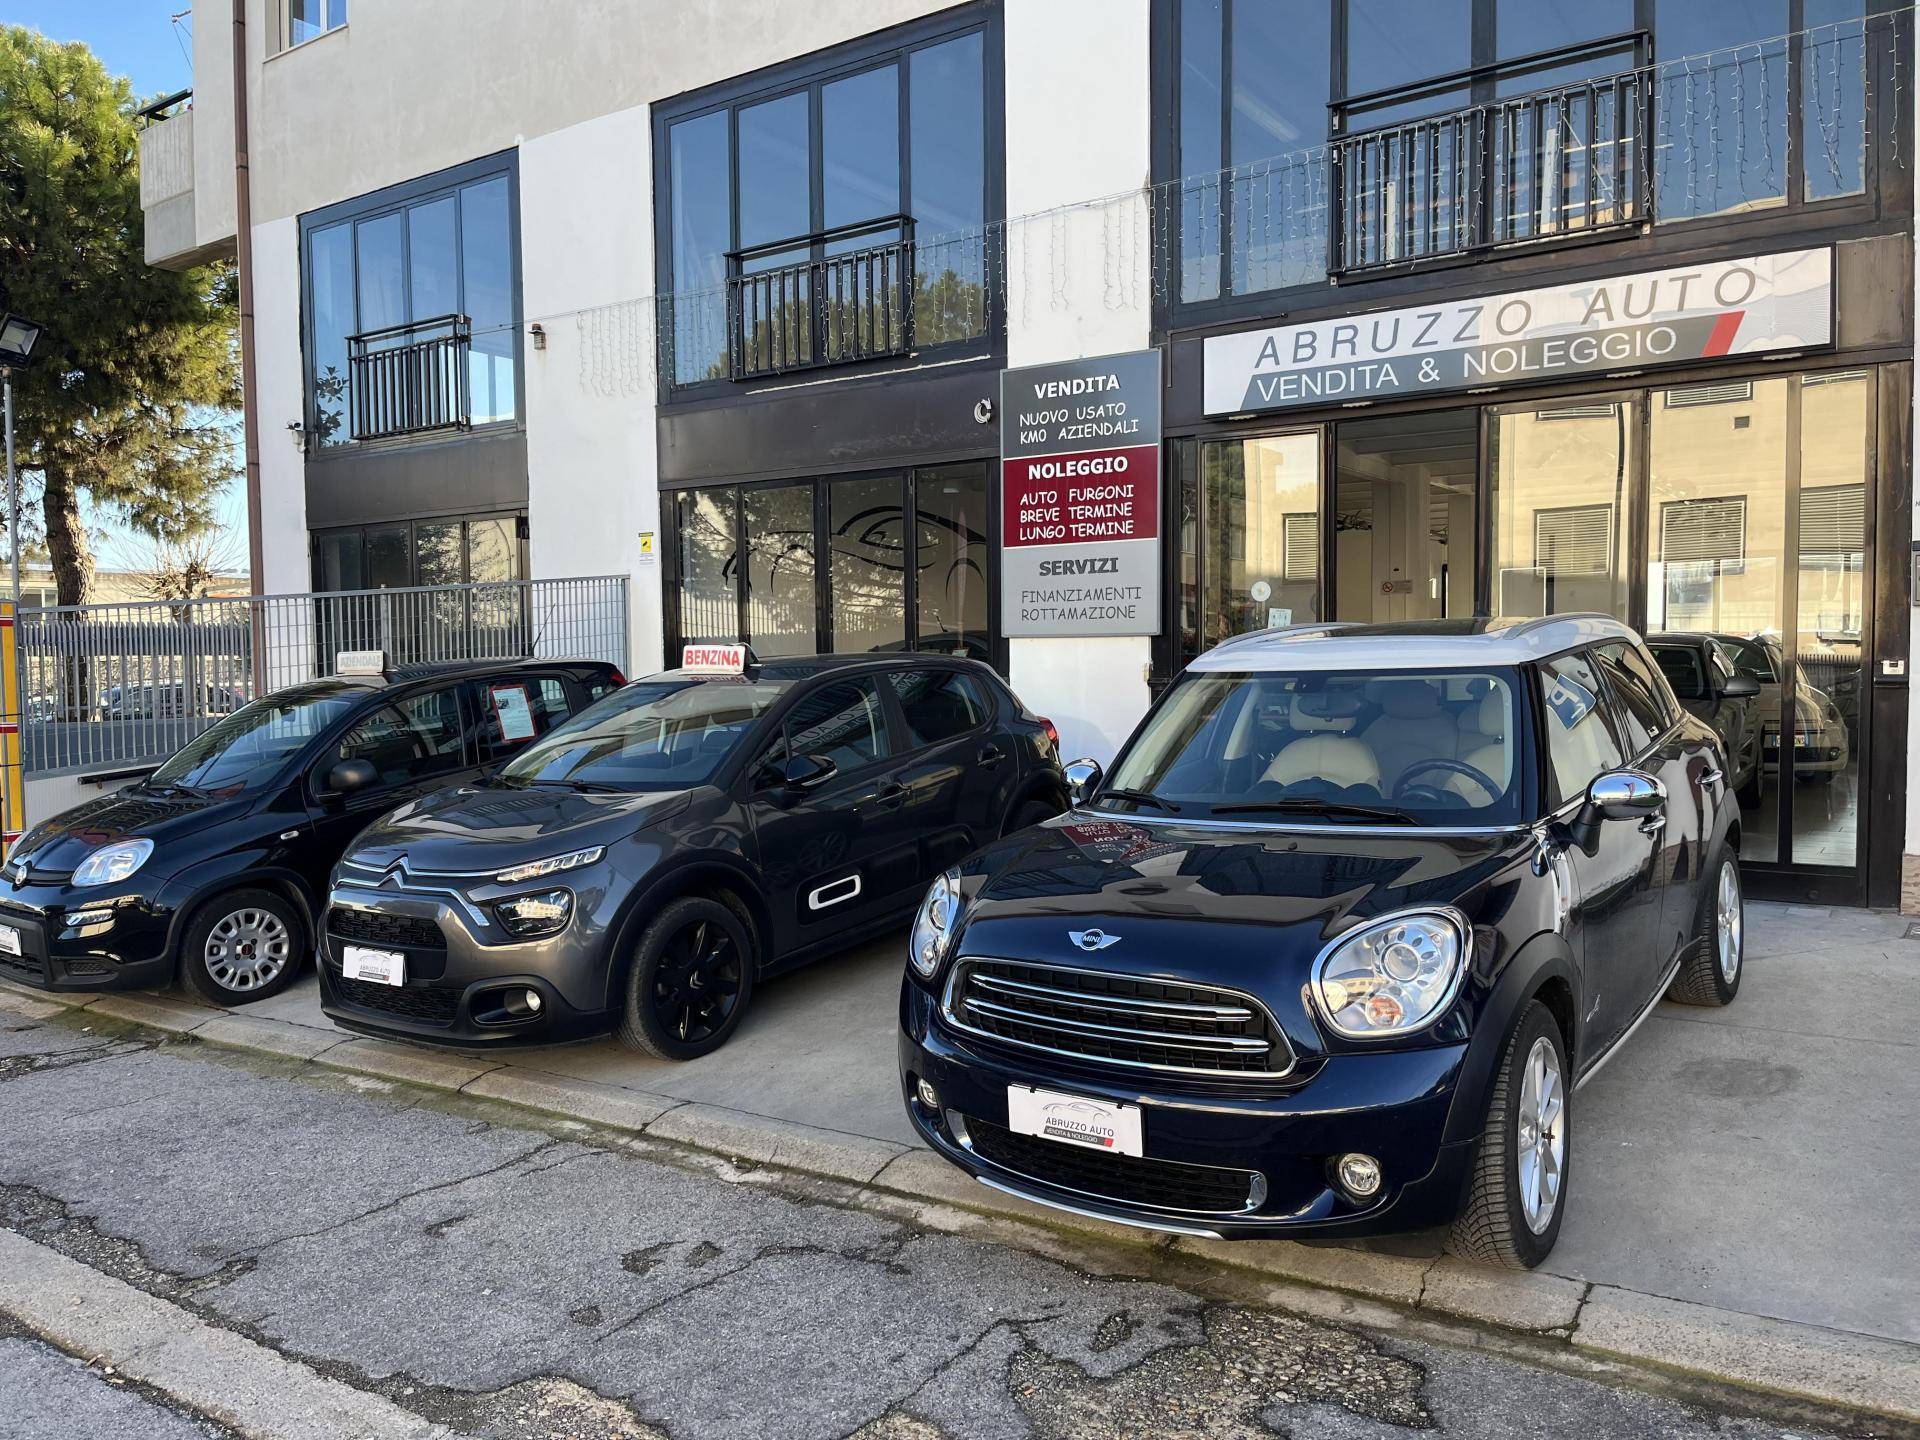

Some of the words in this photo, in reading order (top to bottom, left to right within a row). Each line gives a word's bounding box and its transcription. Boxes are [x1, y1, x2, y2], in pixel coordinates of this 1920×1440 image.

[1254, 300, 1532, 368] ABRUZZO
[1580, 267, 1757, 327] AUTO
[1257, 363, 1399, 402] VENDITA
[1417, 358, 1441, 383] &
[1463, 326, 1678, 379] NOLEGGIO
[1034, 374, 1120, 399] VENDITA
[1019, 409, 1068, 427] NUOVO
[1076, 402, 1126, 420] USATO
[1058, 419, 1139, 440] AZIENDALI
[1028, 456, 1128, 480] NOLEGGIO
[1020, 491, 1057, 505] AUTO
[1069, 485, 1134, 502] FURGONI
[1020, 507, 1060, 523] BREVE
[1068, 502, 1132, 520] TERMINE
[1019, 525, 1065, 540] LUNGO
[1069, 521, 1134, 537] TERMINE
[1039, 557, 1119, 577] SERVIZI
[1021, 587, 1142, 603] FINANZIAMENTI
[1021, 605, 1136, 621] ROTTAMAZIONE
[685, 649, 741, 666] BENZINA
[1082, 935, 1101, 943] MINI
[1045, 1116, 1087, 1132] ABRUZZO
[1090, 1125, 1114, 1137] AUTO
[1046, 1127, 1067, 1137] VENDITA
[1071, 1132, 1098, 1143] NOLEGGIO
